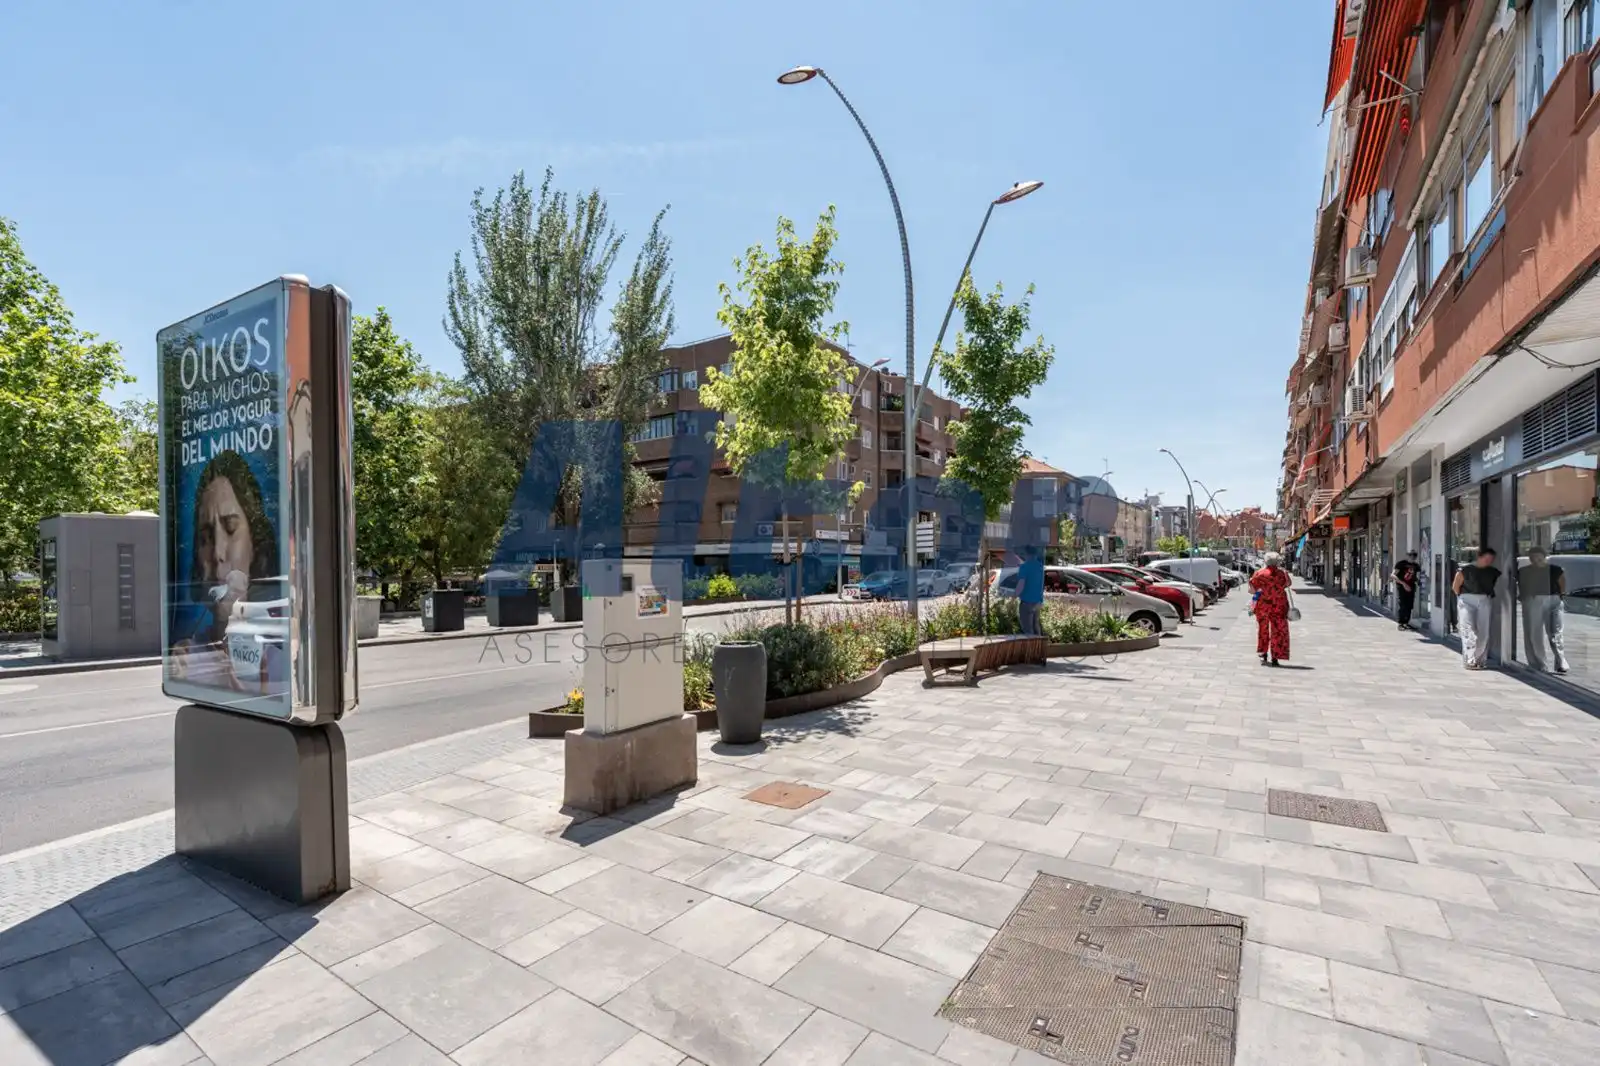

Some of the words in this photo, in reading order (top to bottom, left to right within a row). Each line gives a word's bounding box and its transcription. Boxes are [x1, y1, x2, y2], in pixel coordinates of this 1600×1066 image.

[180, 317, 271, 390] OIKOS
[180, 389, 209, 416] PARA
[212, 369, 271, 404] MUCHOS
[182, 420, 192, 437] EL
[193, 410, 229, 435] MEJOR
[231, 398, 272, 423] YOGUR
[181, 438, 206, 467] DEL
[210, 423, 273, 459] MUNDO
